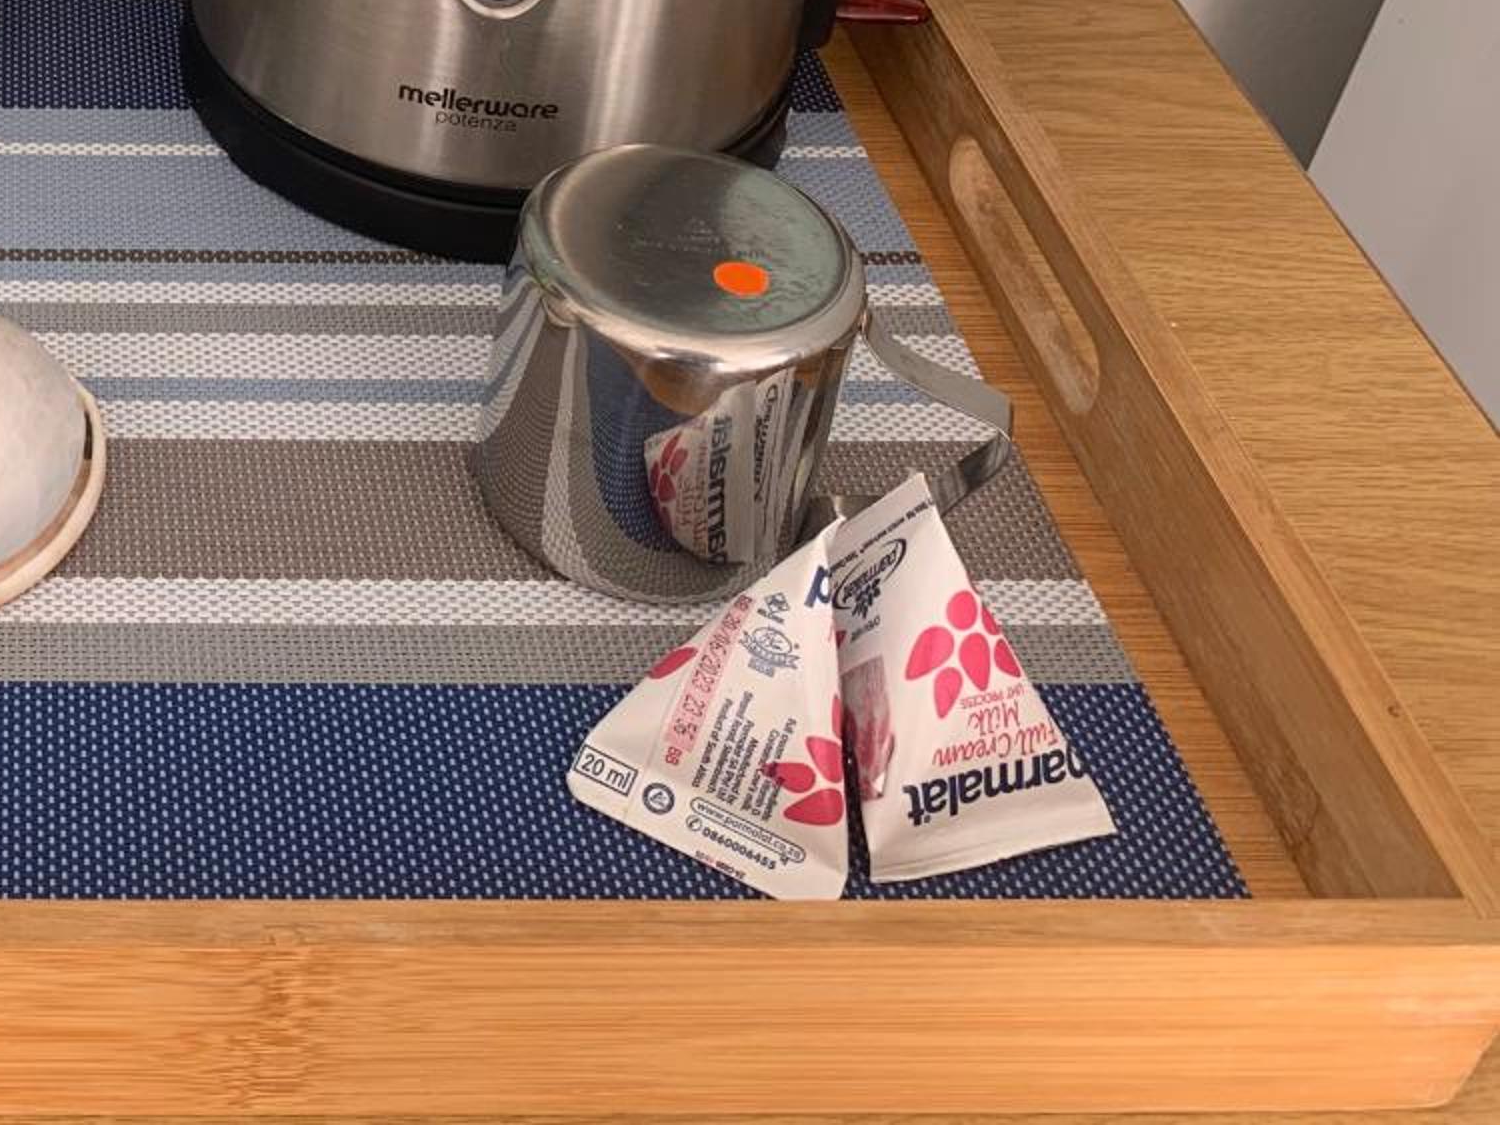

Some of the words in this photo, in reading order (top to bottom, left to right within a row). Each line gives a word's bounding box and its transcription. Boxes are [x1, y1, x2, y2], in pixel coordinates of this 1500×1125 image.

[399, 83, 559, 120] mellerware
[435, 110, 517, 132] potenza
[968, 702, 1021, 736] Milk
[932, 734, 1014, 767] Cream
[1015, 721, 1059, 757] Full
[580, 752, 607, 777] 20
[605, 765, 632, 790] ml
